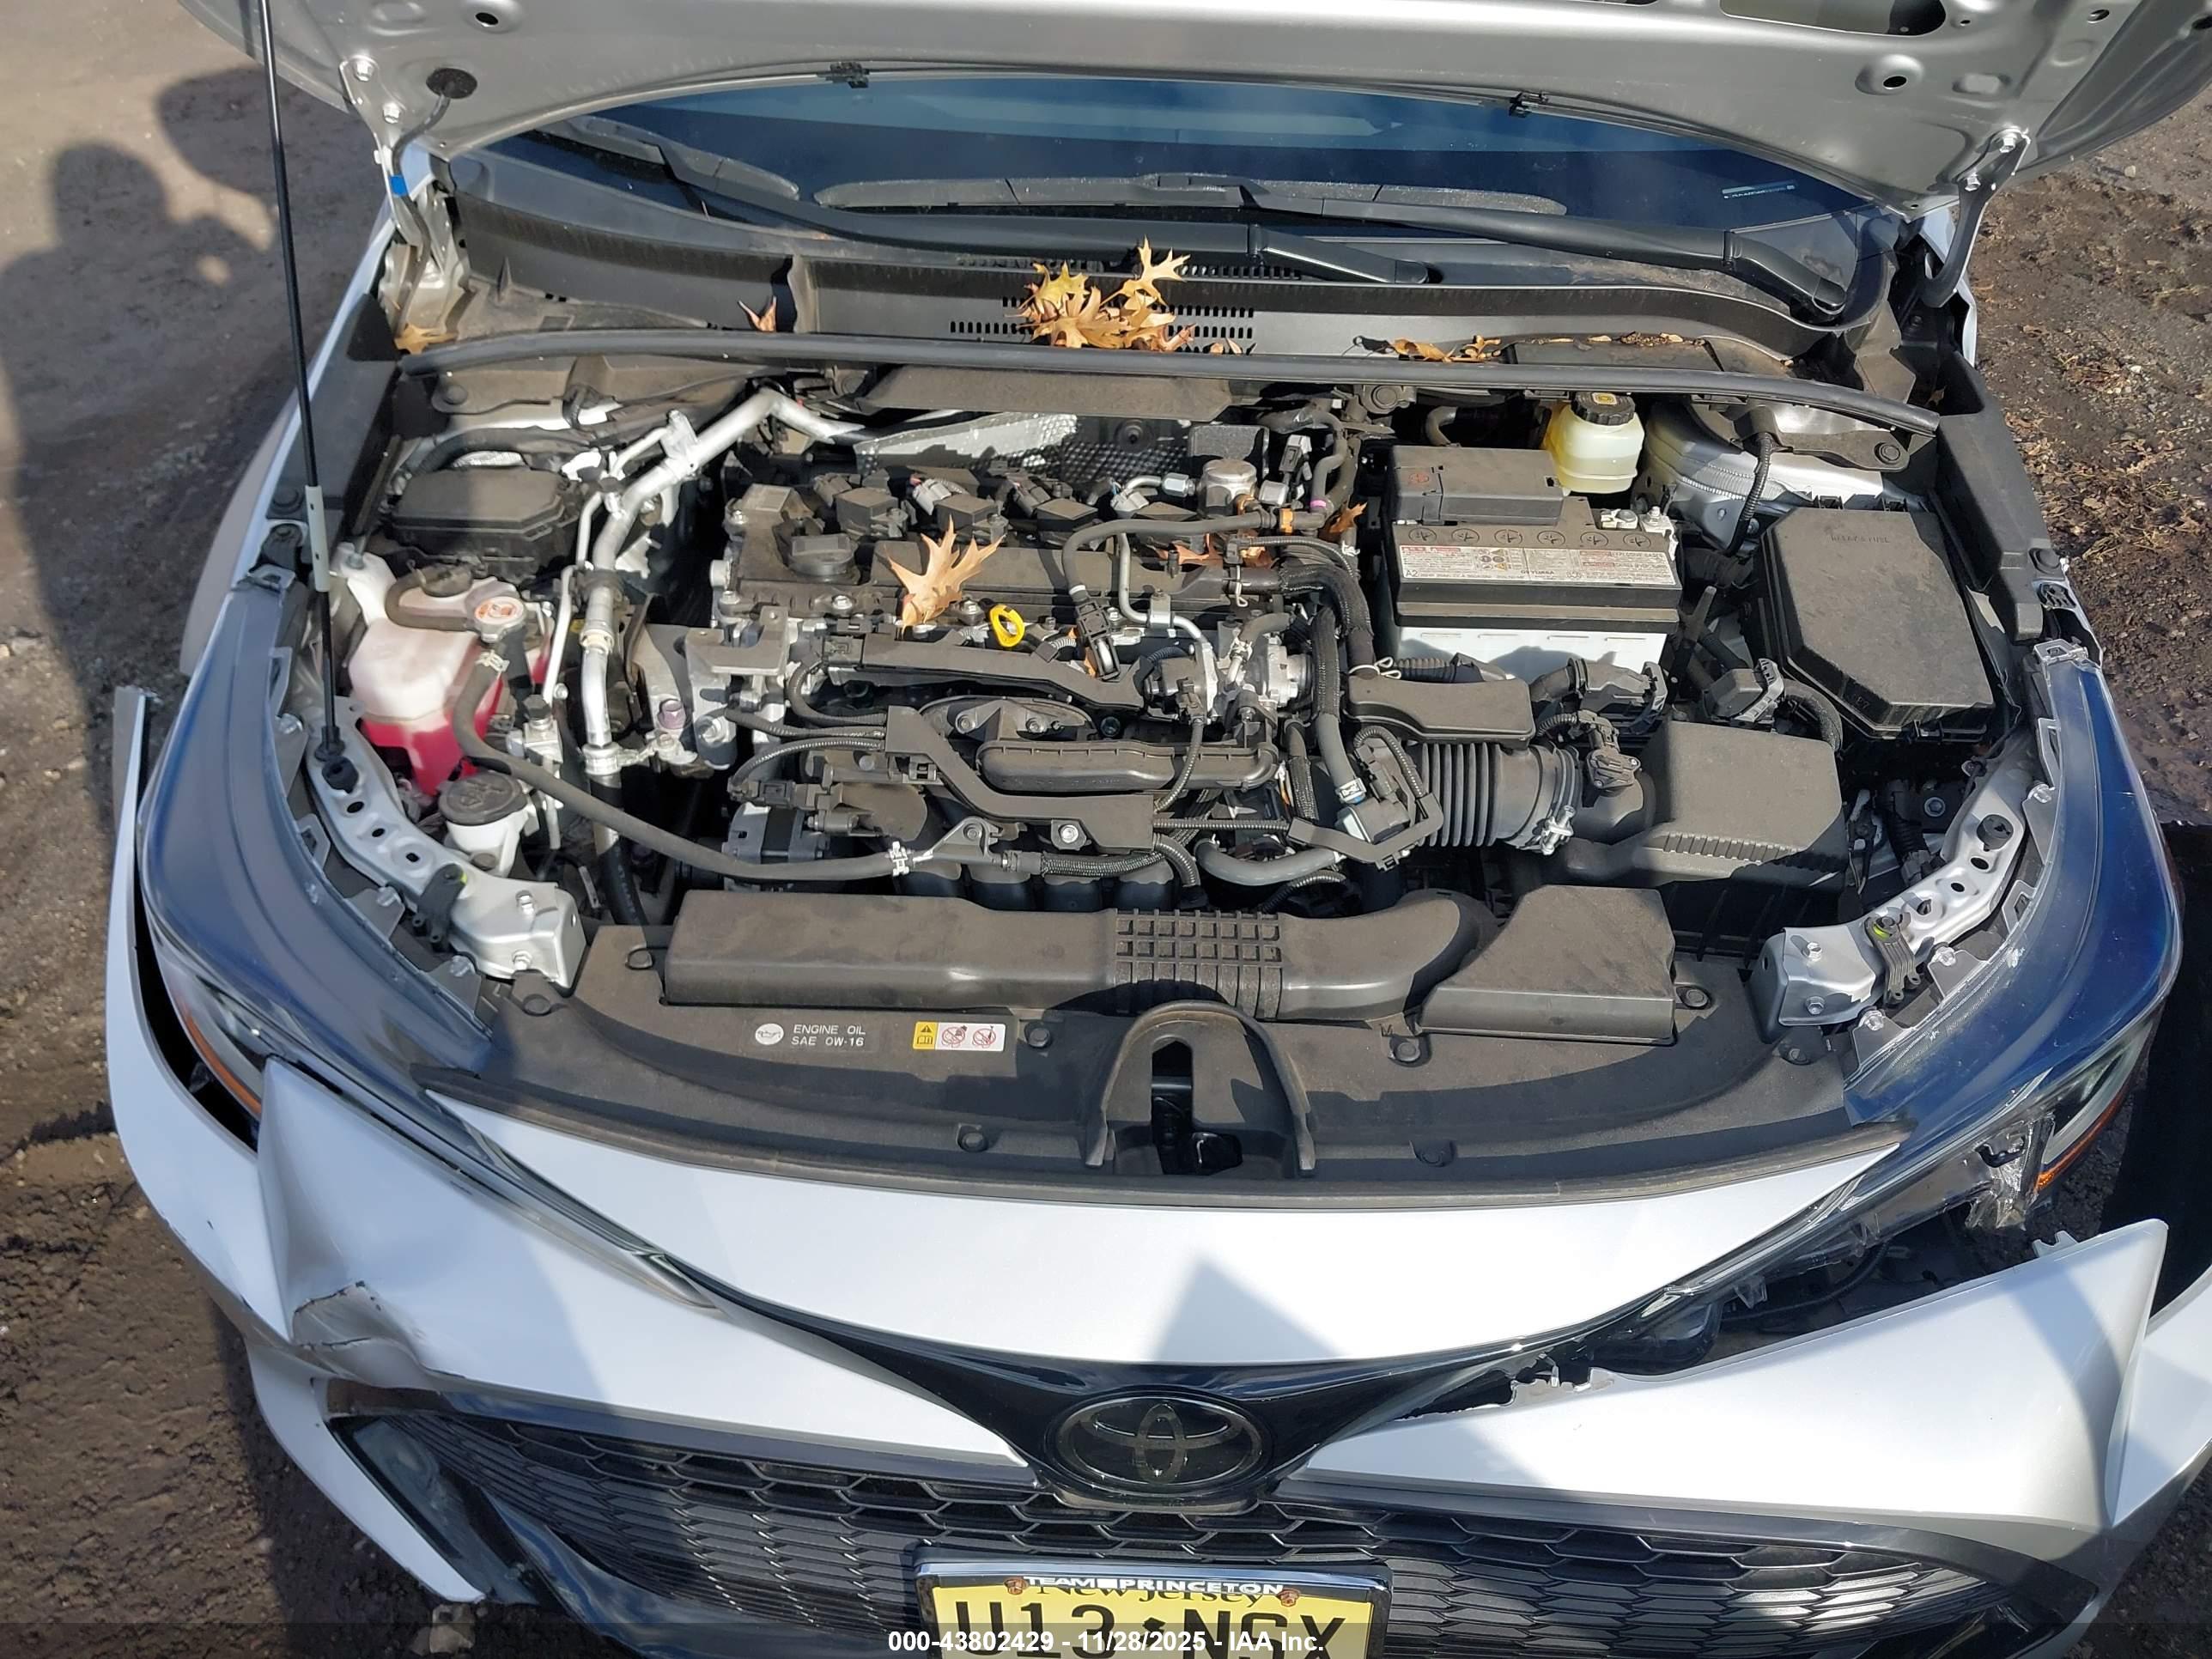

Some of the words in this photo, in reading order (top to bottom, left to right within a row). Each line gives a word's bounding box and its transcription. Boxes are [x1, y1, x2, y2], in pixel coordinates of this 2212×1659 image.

[793, 1024, 838, 1035] ENGINE
[848, 1024, 866, 1036] OIL
[791, 1036, 817, 1046] SAE
[1024, 1576, 1096, 1589] TEAM
[1119, 1577, 1284, 1595] PRINCETON
